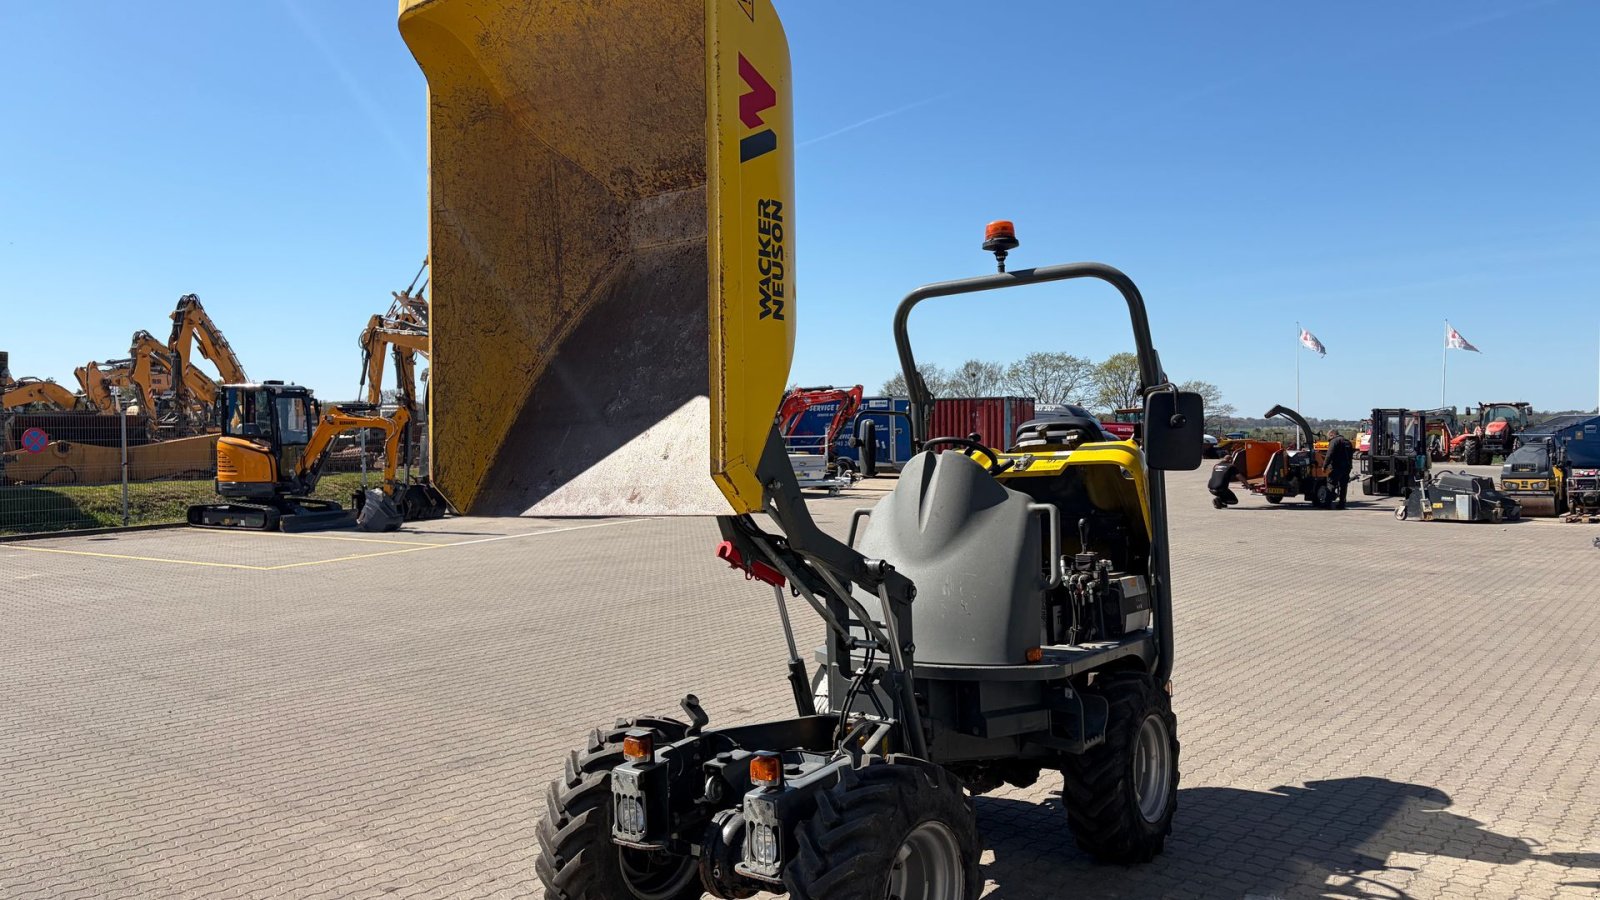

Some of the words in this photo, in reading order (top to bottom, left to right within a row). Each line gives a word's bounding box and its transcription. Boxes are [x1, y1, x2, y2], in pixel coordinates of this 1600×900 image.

[758, 198, 772, 320] WACKER
[771, 199, 784, 320] NEUSON
[809, 404, 835, 412] SERVICE
